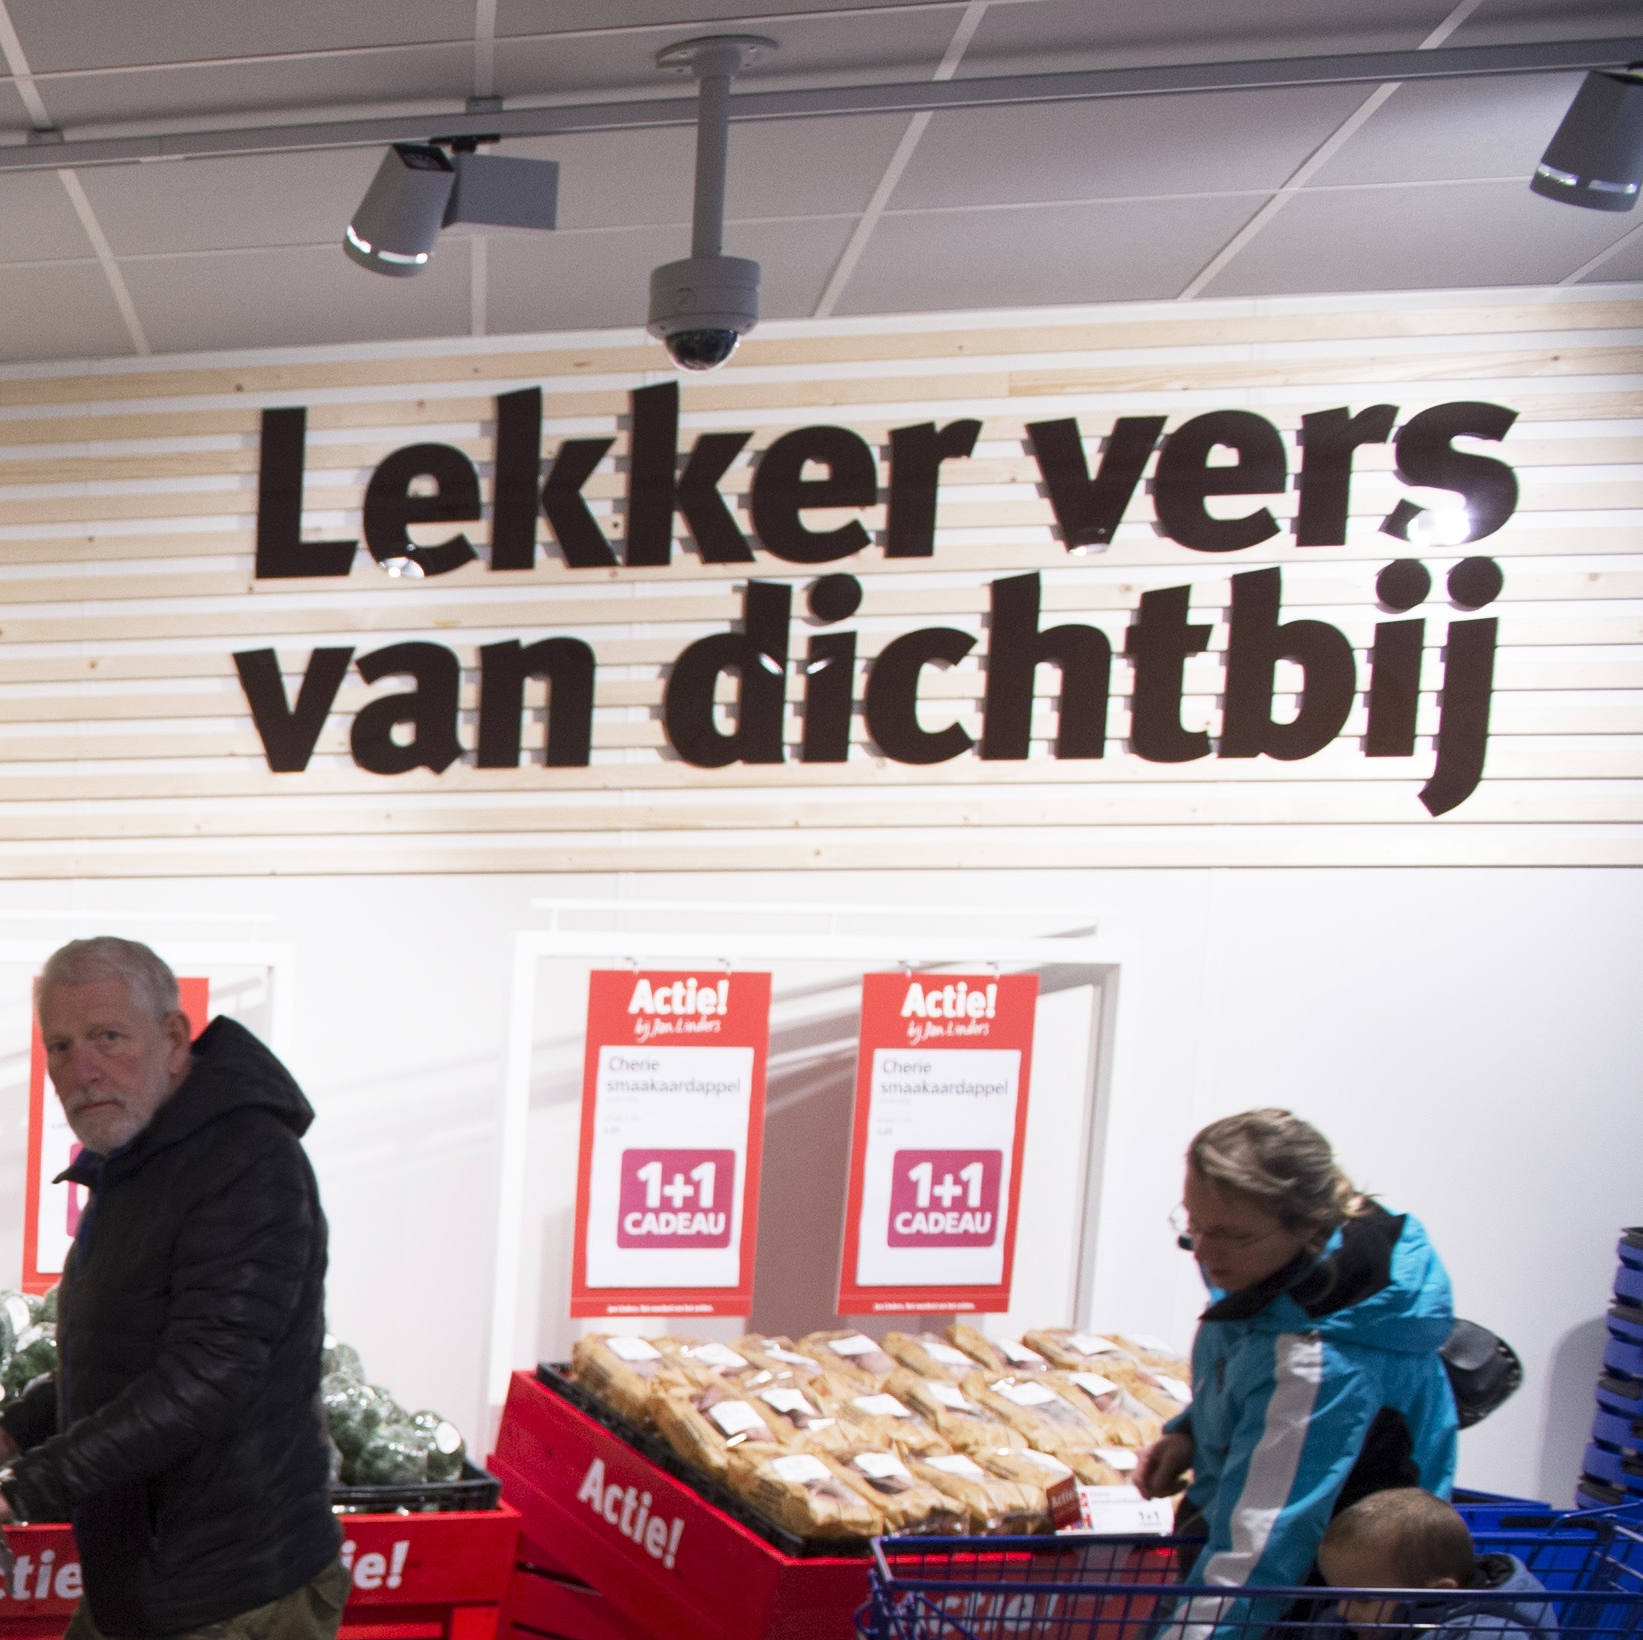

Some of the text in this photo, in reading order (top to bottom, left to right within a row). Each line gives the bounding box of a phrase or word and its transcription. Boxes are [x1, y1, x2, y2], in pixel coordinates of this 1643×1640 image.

[255, 380, 1520, 581] Lekker vers
[232, 555, 1505, 818] van dichtbij
[627, 977, 729, 1015] Actie!
[900, 981, 997, 1018] Actie!
[607, 1077, 741, 1096] smaakaardappel
[881, 1079, 1009, 1098] smaakaardappel
[636, 1161, 716, 1208] 1+1
[908, 1162, 983, 1208] 1+1
[623, 1212, 726, 1235] CADEAU
[894, 1212, 992, 1234] CADEAU
[577, 1457, 685, 1570] Actie!
